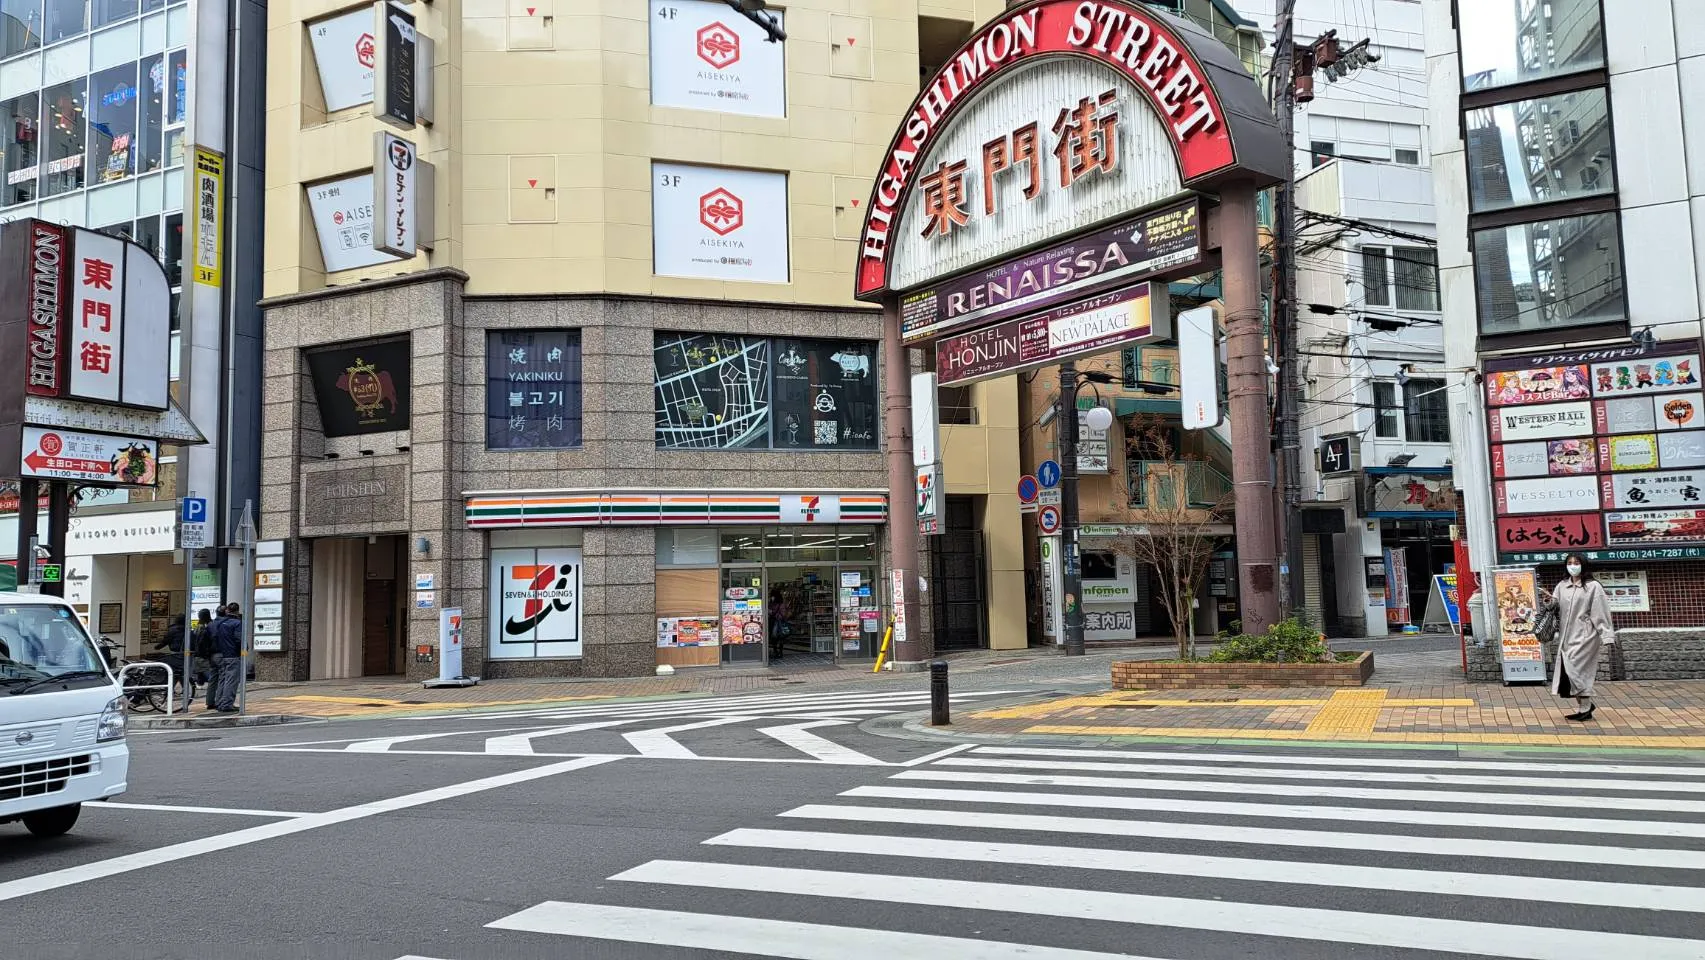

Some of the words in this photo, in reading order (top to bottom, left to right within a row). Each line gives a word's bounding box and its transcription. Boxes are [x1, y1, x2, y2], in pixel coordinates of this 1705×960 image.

[658, 6, 678, 20] 4F
[317, 27, 327, 37] 4F
[696, 71, 741, 82] AISEKIYA
[864, 8, 1040, 263] HIGASHIMON
[1066, 1, 1217, 143] STREET
[918, 87, 1120, 242] 東門街
[661, 174, 682, 188] 3F
[201, 177, 215, 223] 肉酒場
[346, 204, 374, 221] AISE
[699, 238, 745, 249] AISEKIYA
[986, 267, 1008, 280] HOTEL
[1023, 256, 1046, 268] Nature
[1046, 246, 1075, 260] Relaxing
[948, 241, 1129, 317] RENAISSA
[30, 227, 61, 389] HIGASHIMON
[1056, 294, 1122, 317] リニューアルオープン
[80, 257, 114, 375] 東門街
[960, 328, 1004, 348] HOTEL
[1052, 326, 1082, 345] NEW
[1083, 312, 1130, 337] PALACE
[508, 346, 563, 365] 焼肉
[949, 336, 1017, 370] HONJIN
[508, 371, 563, 382] YAKINIKU
[962, 361, 1004, 376] リニューアルオープン
[508, 390, 563, 407] 불고기
[1488, 379, 1497, 400] 4F
[1663, 401, 1692, 412] Golden
[1666, 411, 1690, 420] Cups
[508, 413, 563, 432] 烤肉
[1491, 415, 1501, 435] 3F
[1505, 413, 1556, 429] WESTERN
[1557, 411, 1586, 422] HALL
[1596, 406, 1605, 427] 5F
[67, 440, 105, 454] 賀正軒
[1600, 443, 1609, 465] 6F
[46, 457, 104, 471] 生田ロード南へ
[1493, 451, 1502, 472] 7F
[1498, 487, 1505, 508] 1F
[1508, 488, 1596, 501] WESSELTON
[1603, 481, 1612, 502] 2F
[1625, 486, 1651, 505] 魚
[188, 500, 203, 520] P
[74, 530, 118, 539] MISONO
[1506, 515, 1591, 546] はちきん
[1616, 550, 1639, 560] (078)
[1641, 548, 1683, 559] 241-7287
[1685, 547, 1700, 557] (代)
[537, 590, 573, 598] HOLDINGS
[1084, 610, 1133, 631] 案内所
